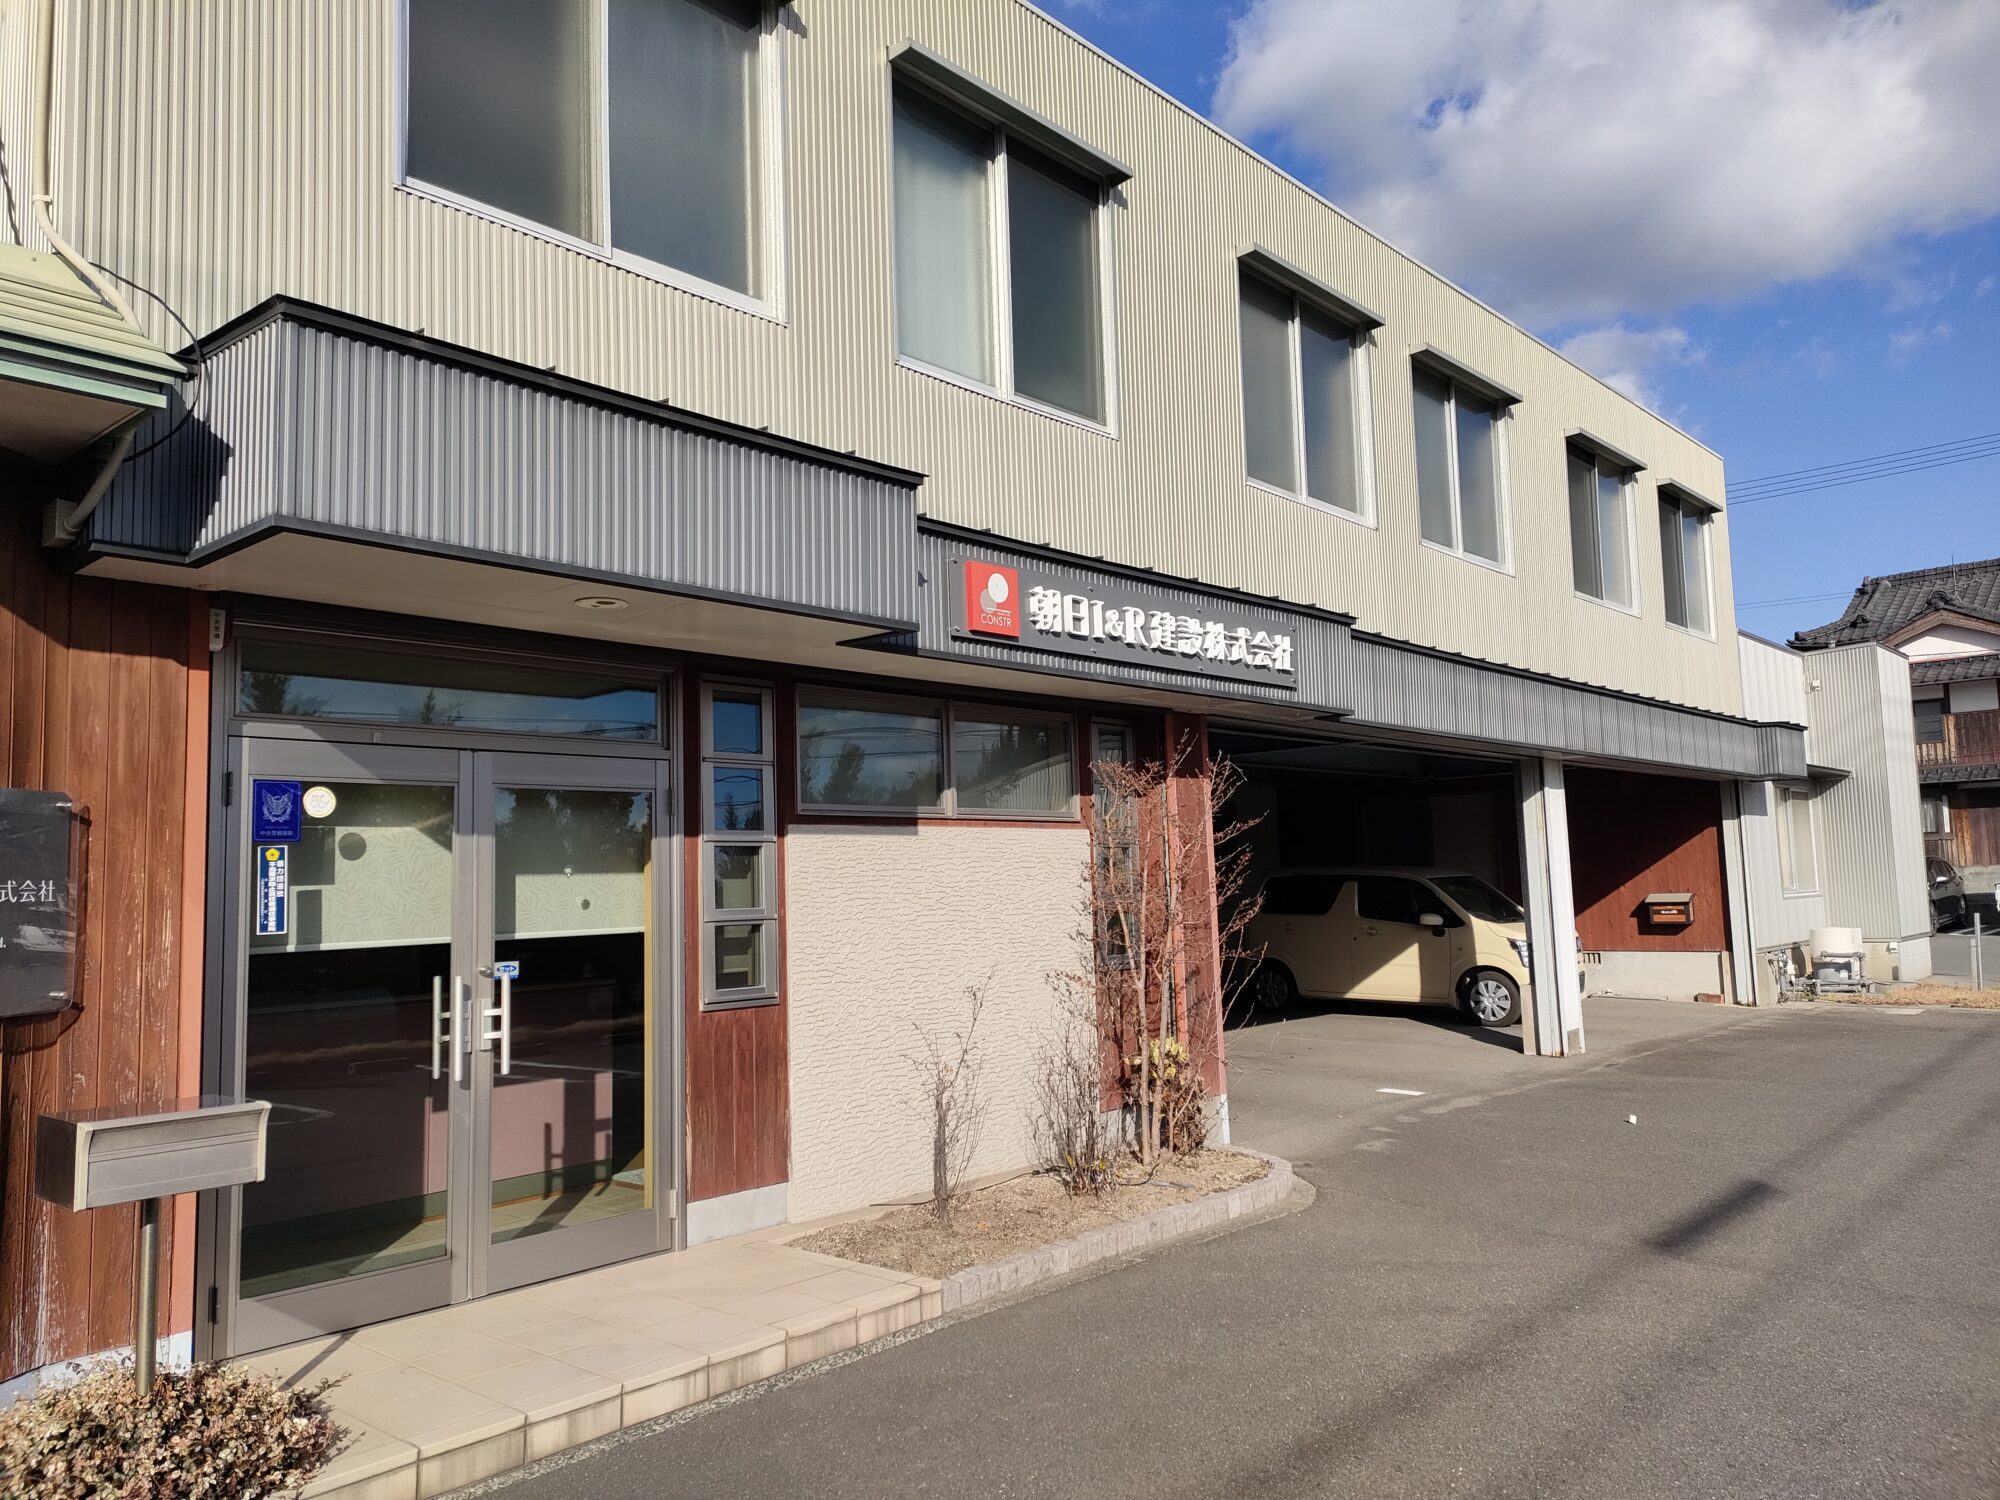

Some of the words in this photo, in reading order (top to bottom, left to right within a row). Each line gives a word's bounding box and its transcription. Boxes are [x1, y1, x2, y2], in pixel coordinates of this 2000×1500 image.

[981, 613, 1012, 628] CONSTR
[1029, 585, 1295, 672] 朝日I&R建設株式会社
